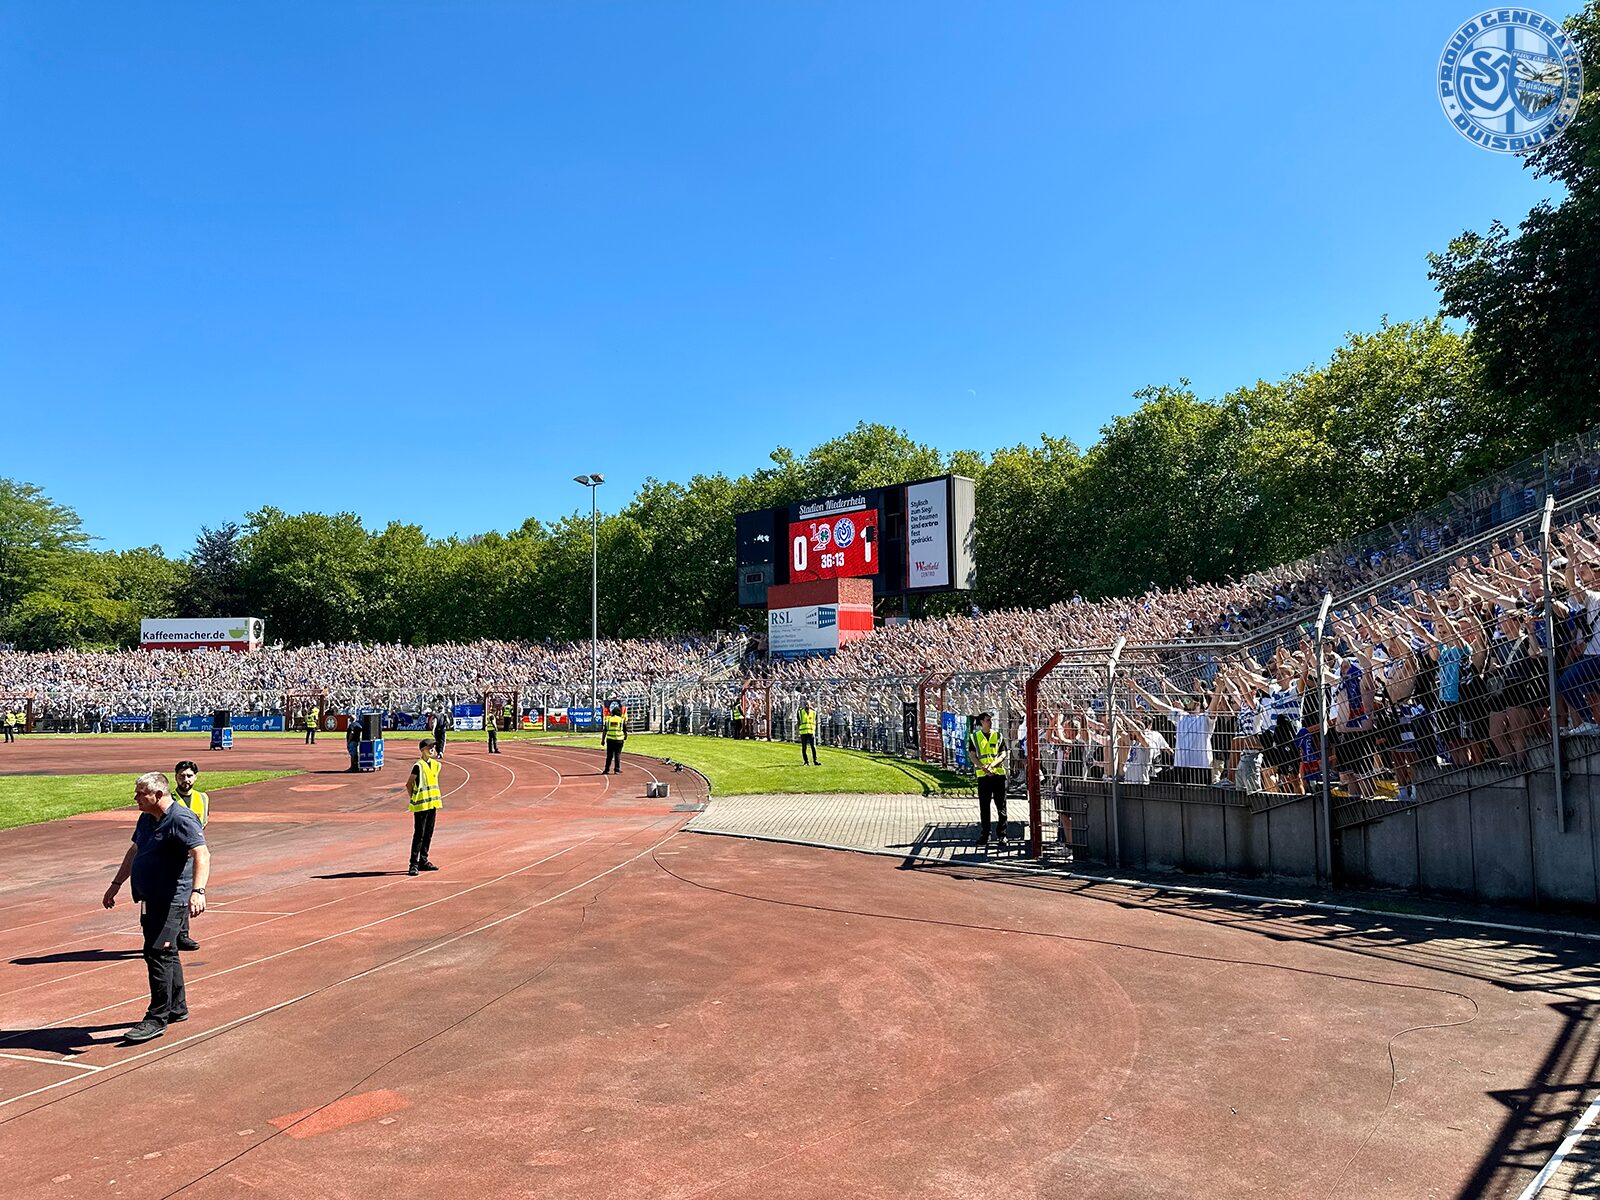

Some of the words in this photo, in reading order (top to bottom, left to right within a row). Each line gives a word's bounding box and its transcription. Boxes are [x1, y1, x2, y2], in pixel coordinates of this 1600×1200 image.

[799, 503, 824, 515] Stadion
[825, 495, 866, 510] Niederrhein
[921, 506, 933, 514] Sieg!
[919, 513, 938, 521] Daumen
[910, 522, 921, 530] sind
[860, 526, 872, 563] 1
[793, 535, 808, 572] 0
[820, 552, 845, 569] 36:13
[915, 561, 939, 571] Westfield
[771, 611, 793, 625] RSL
[142, 630, 225, 640] Kaffeemacher.de
